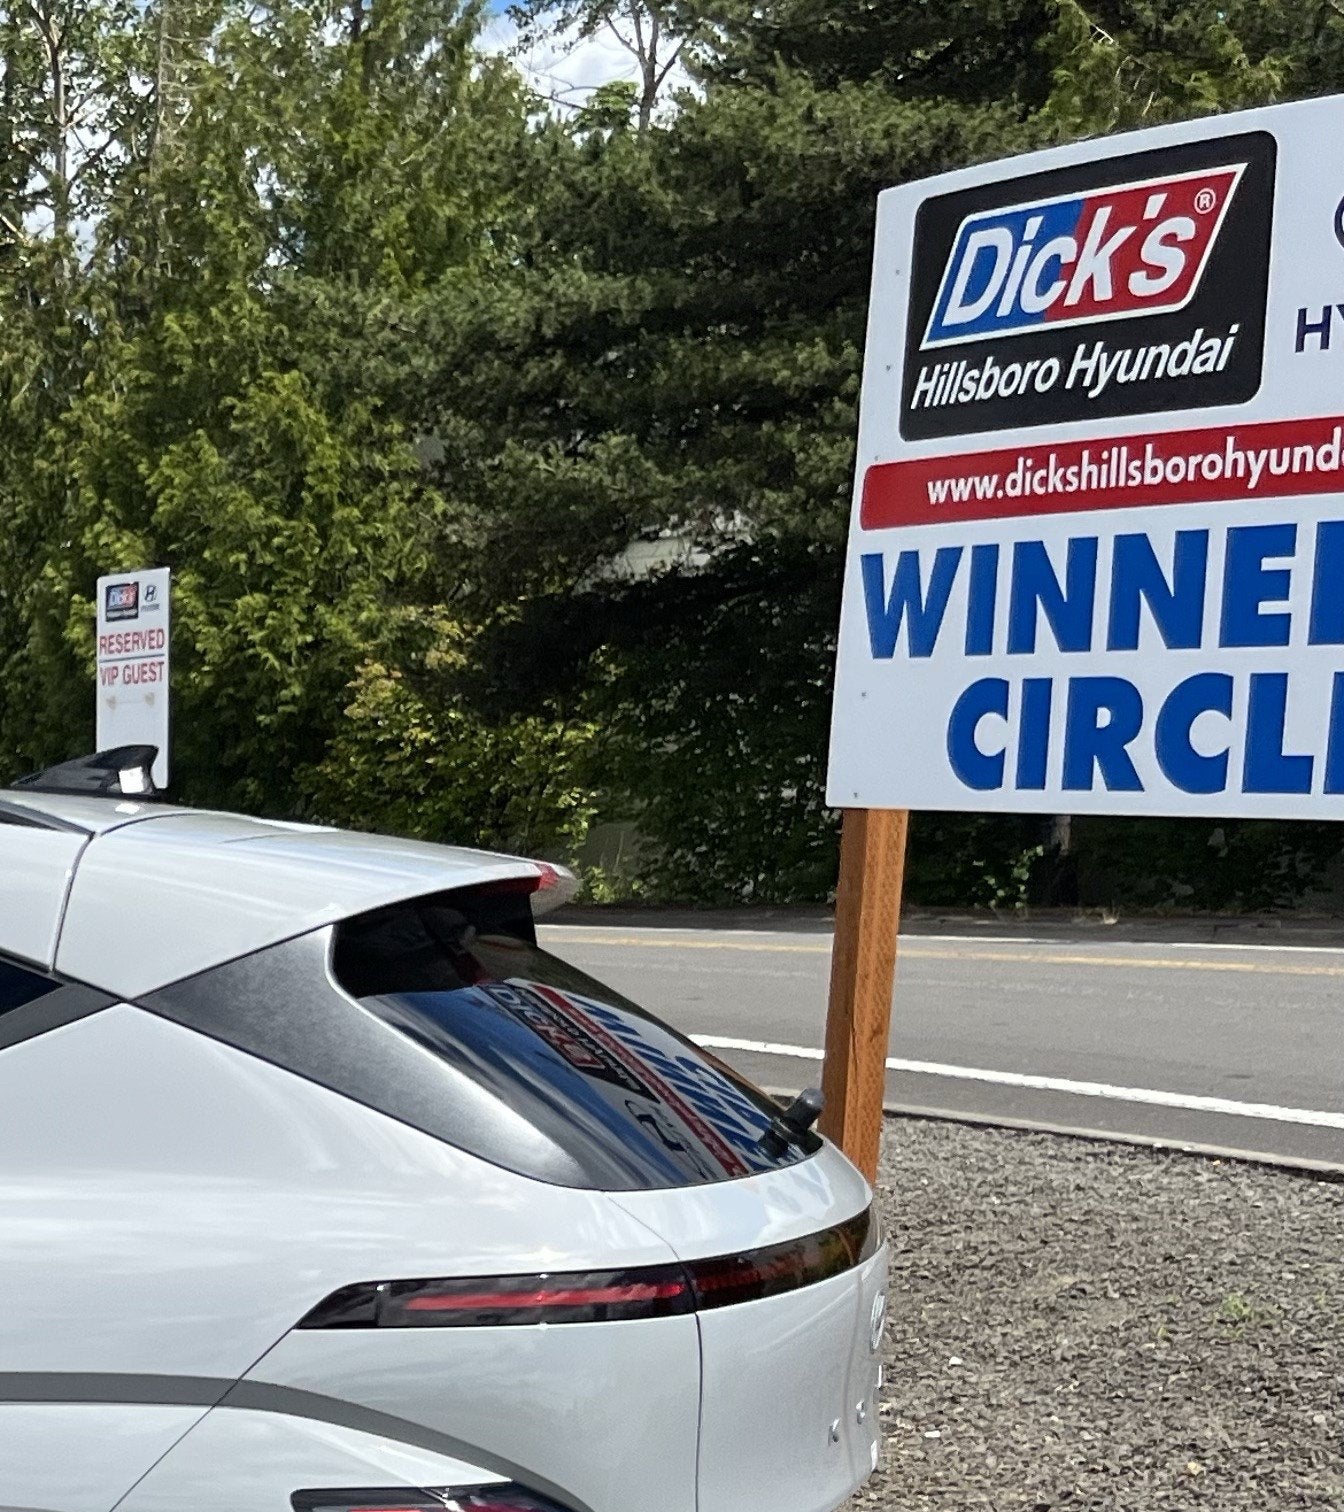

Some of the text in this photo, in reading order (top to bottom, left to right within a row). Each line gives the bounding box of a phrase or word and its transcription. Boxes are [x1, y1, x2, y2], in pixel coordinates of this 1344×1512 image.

[942, 192, 1196, 327] Dick's
[911, 323, 1239, 410] Hillsboro Hyundai
[927, 425, 1344, 505] www.dickshillsborohyund
[100, 628, 165, 655] RESERVED
[100, 661, 164, 687] VIP GUEST
[946, 670, 1344, 795] CIRCL
